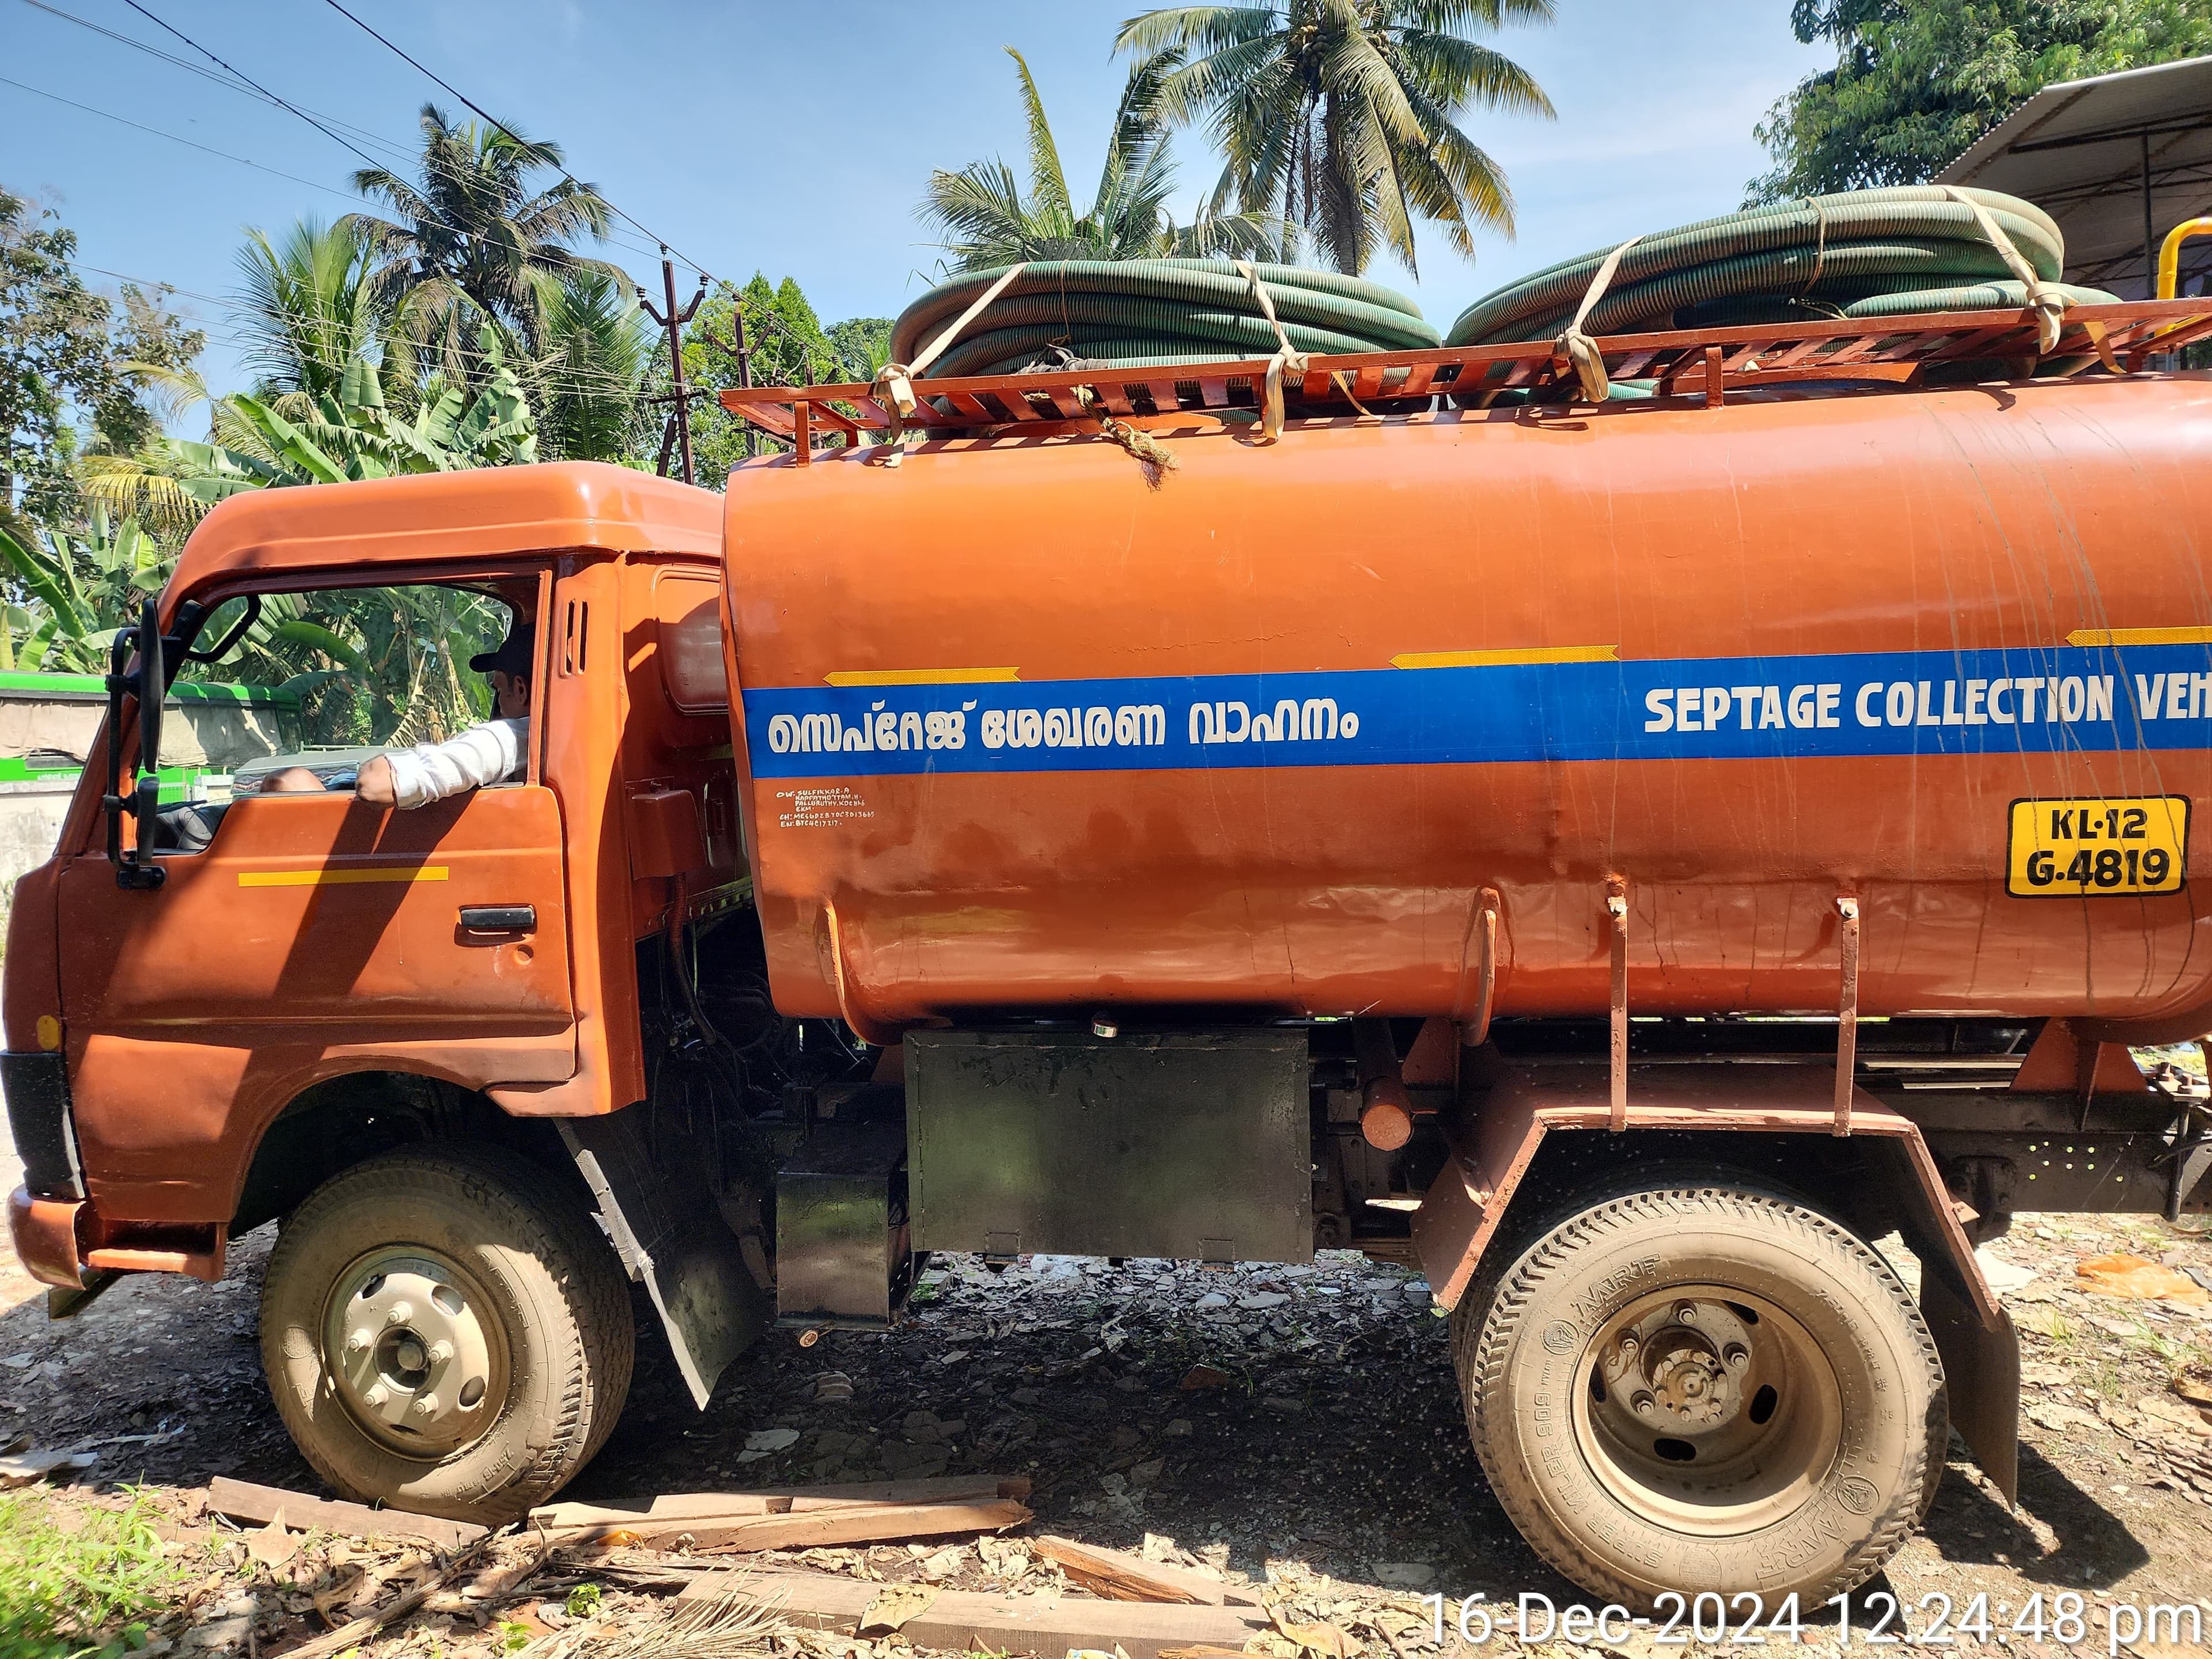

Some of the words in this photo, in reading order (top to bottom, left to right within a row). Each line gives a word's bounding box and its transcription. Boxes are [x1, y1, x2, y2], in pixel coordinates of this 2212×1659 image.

[981, 704, 1166, 749] ശേഖരണ
[1187, 698, 1360, 745] വാഹനം
[1645, 683, 1842, 733] SEPTAGE
[1855, 675, 2114, 727] COLLECTION
[1572, 1252, 1661, 1320] MRF
[1535, 1392, 1554, 1437] 909
[1541, 1443, 1588, 1514] MILER
[1586, 1512, 1663, 1569] SUPER
[1756, 1514, 1847, 1580] MRF
